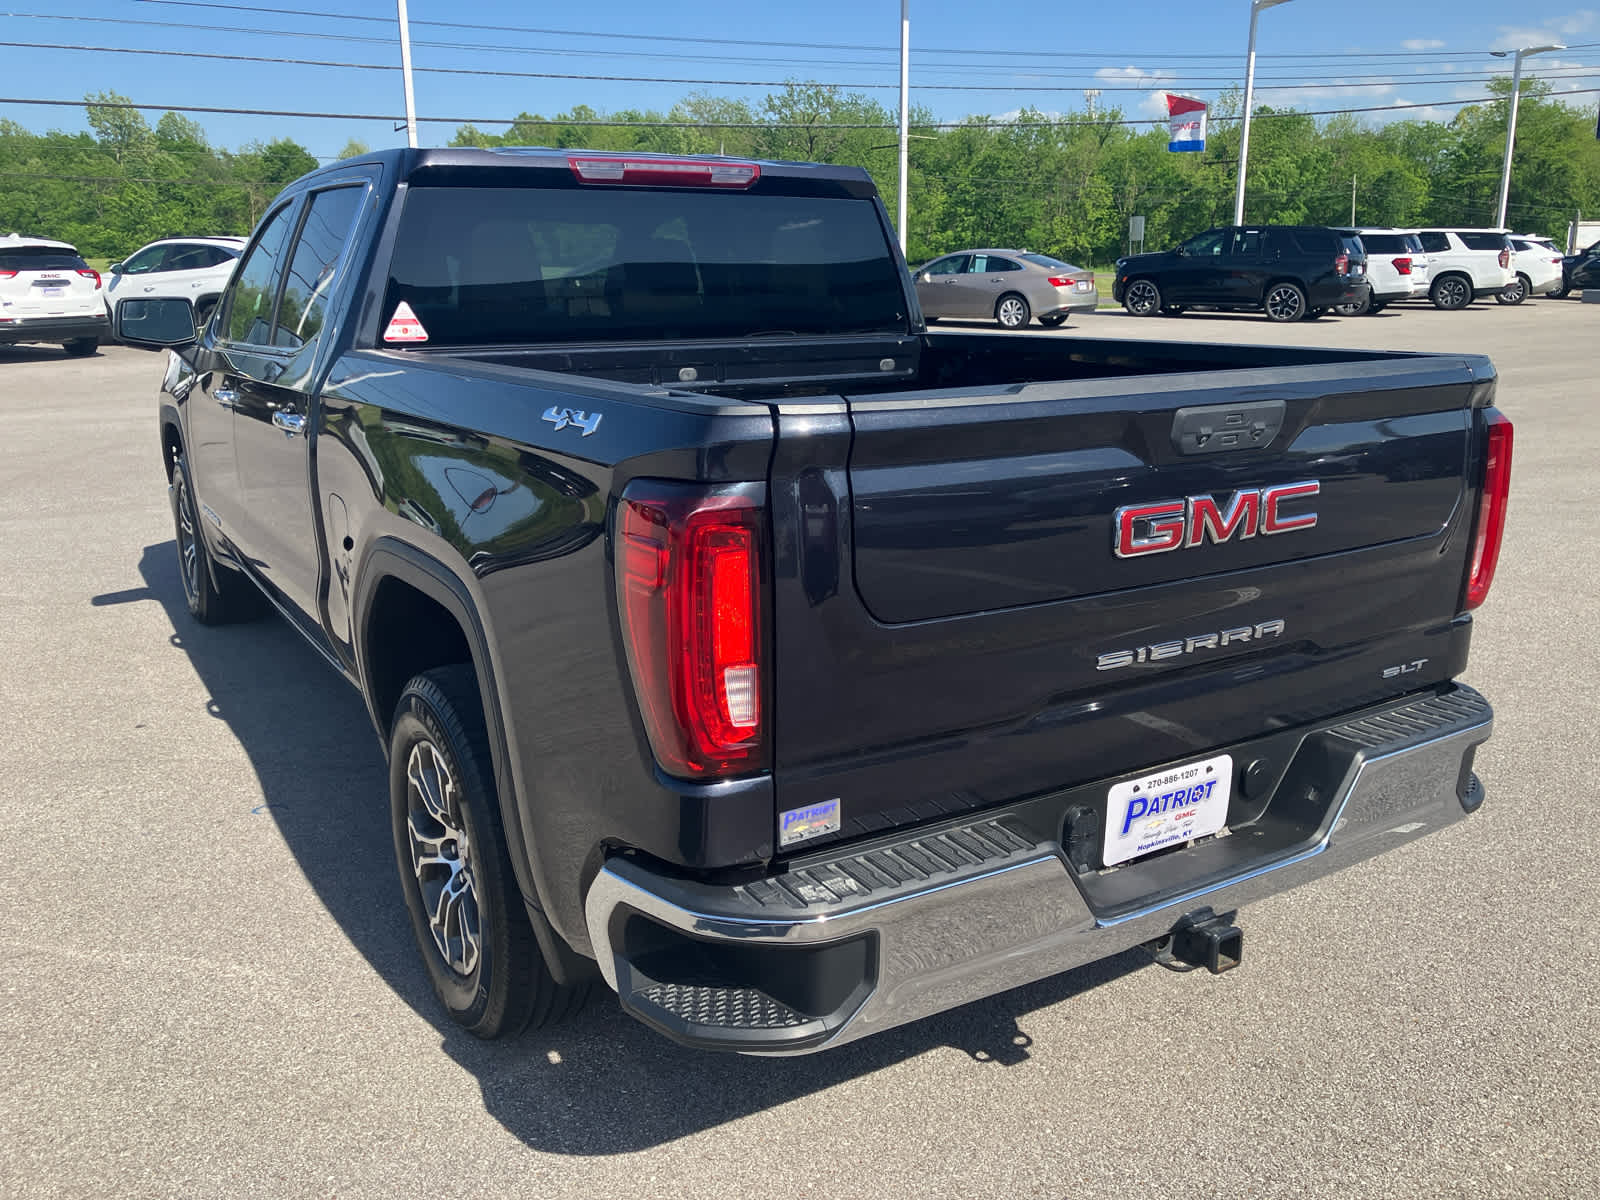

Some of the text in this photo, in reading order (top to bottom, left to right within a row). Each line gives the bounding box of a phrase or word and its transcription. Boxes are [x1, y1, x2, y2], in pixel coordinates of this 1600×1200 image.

[1114, 480, 1320, 559] GMC
[1096, 619, 1285, 671] SIERRA
[1382, 659, 1429, 679] SLT
[1147, 769, 1199, 789] 270-886-1207
[784, 802, 837, 830] PATRIOT
[1121, 780, 1217, 834] PATRIOT
[1174, 809, 1197, 821] GMC
[1182, 830, 1192, 838] KY
